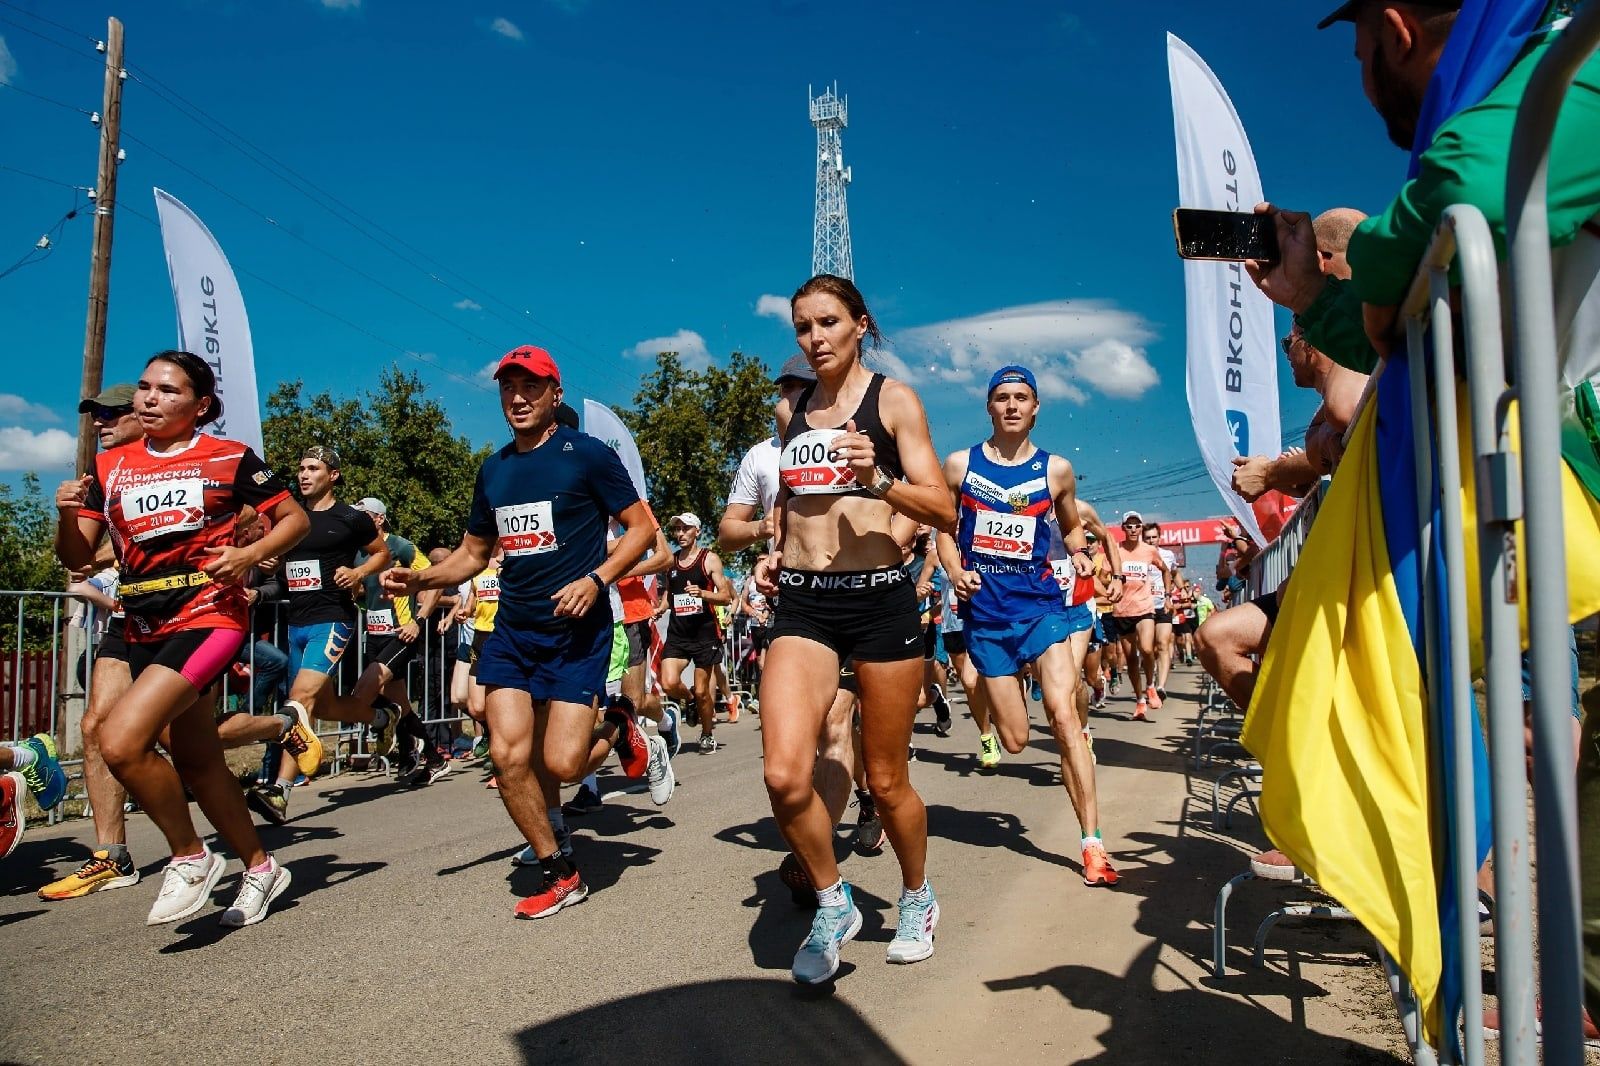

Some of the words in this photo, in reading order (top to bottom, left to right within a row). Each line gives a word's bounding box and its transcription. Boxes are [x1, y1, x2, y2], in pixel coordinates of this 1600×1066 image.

[118, 468, 201, 484] ПАРИЖСКИЙ
[970, 486, 996, 504] System
[971, 477, 1003, 498] Champion
[136, 490, 187, 513] 1042
[504, 514, 539, 533] 1075
[987, 520, 1024, 538] 1249
[290, 566, 311, 578] 1199
[972, 561, 1036, 574] Pentathlon
[810, 574, 867, 589] NIKE
[870, 565, 907, 587] PRO
